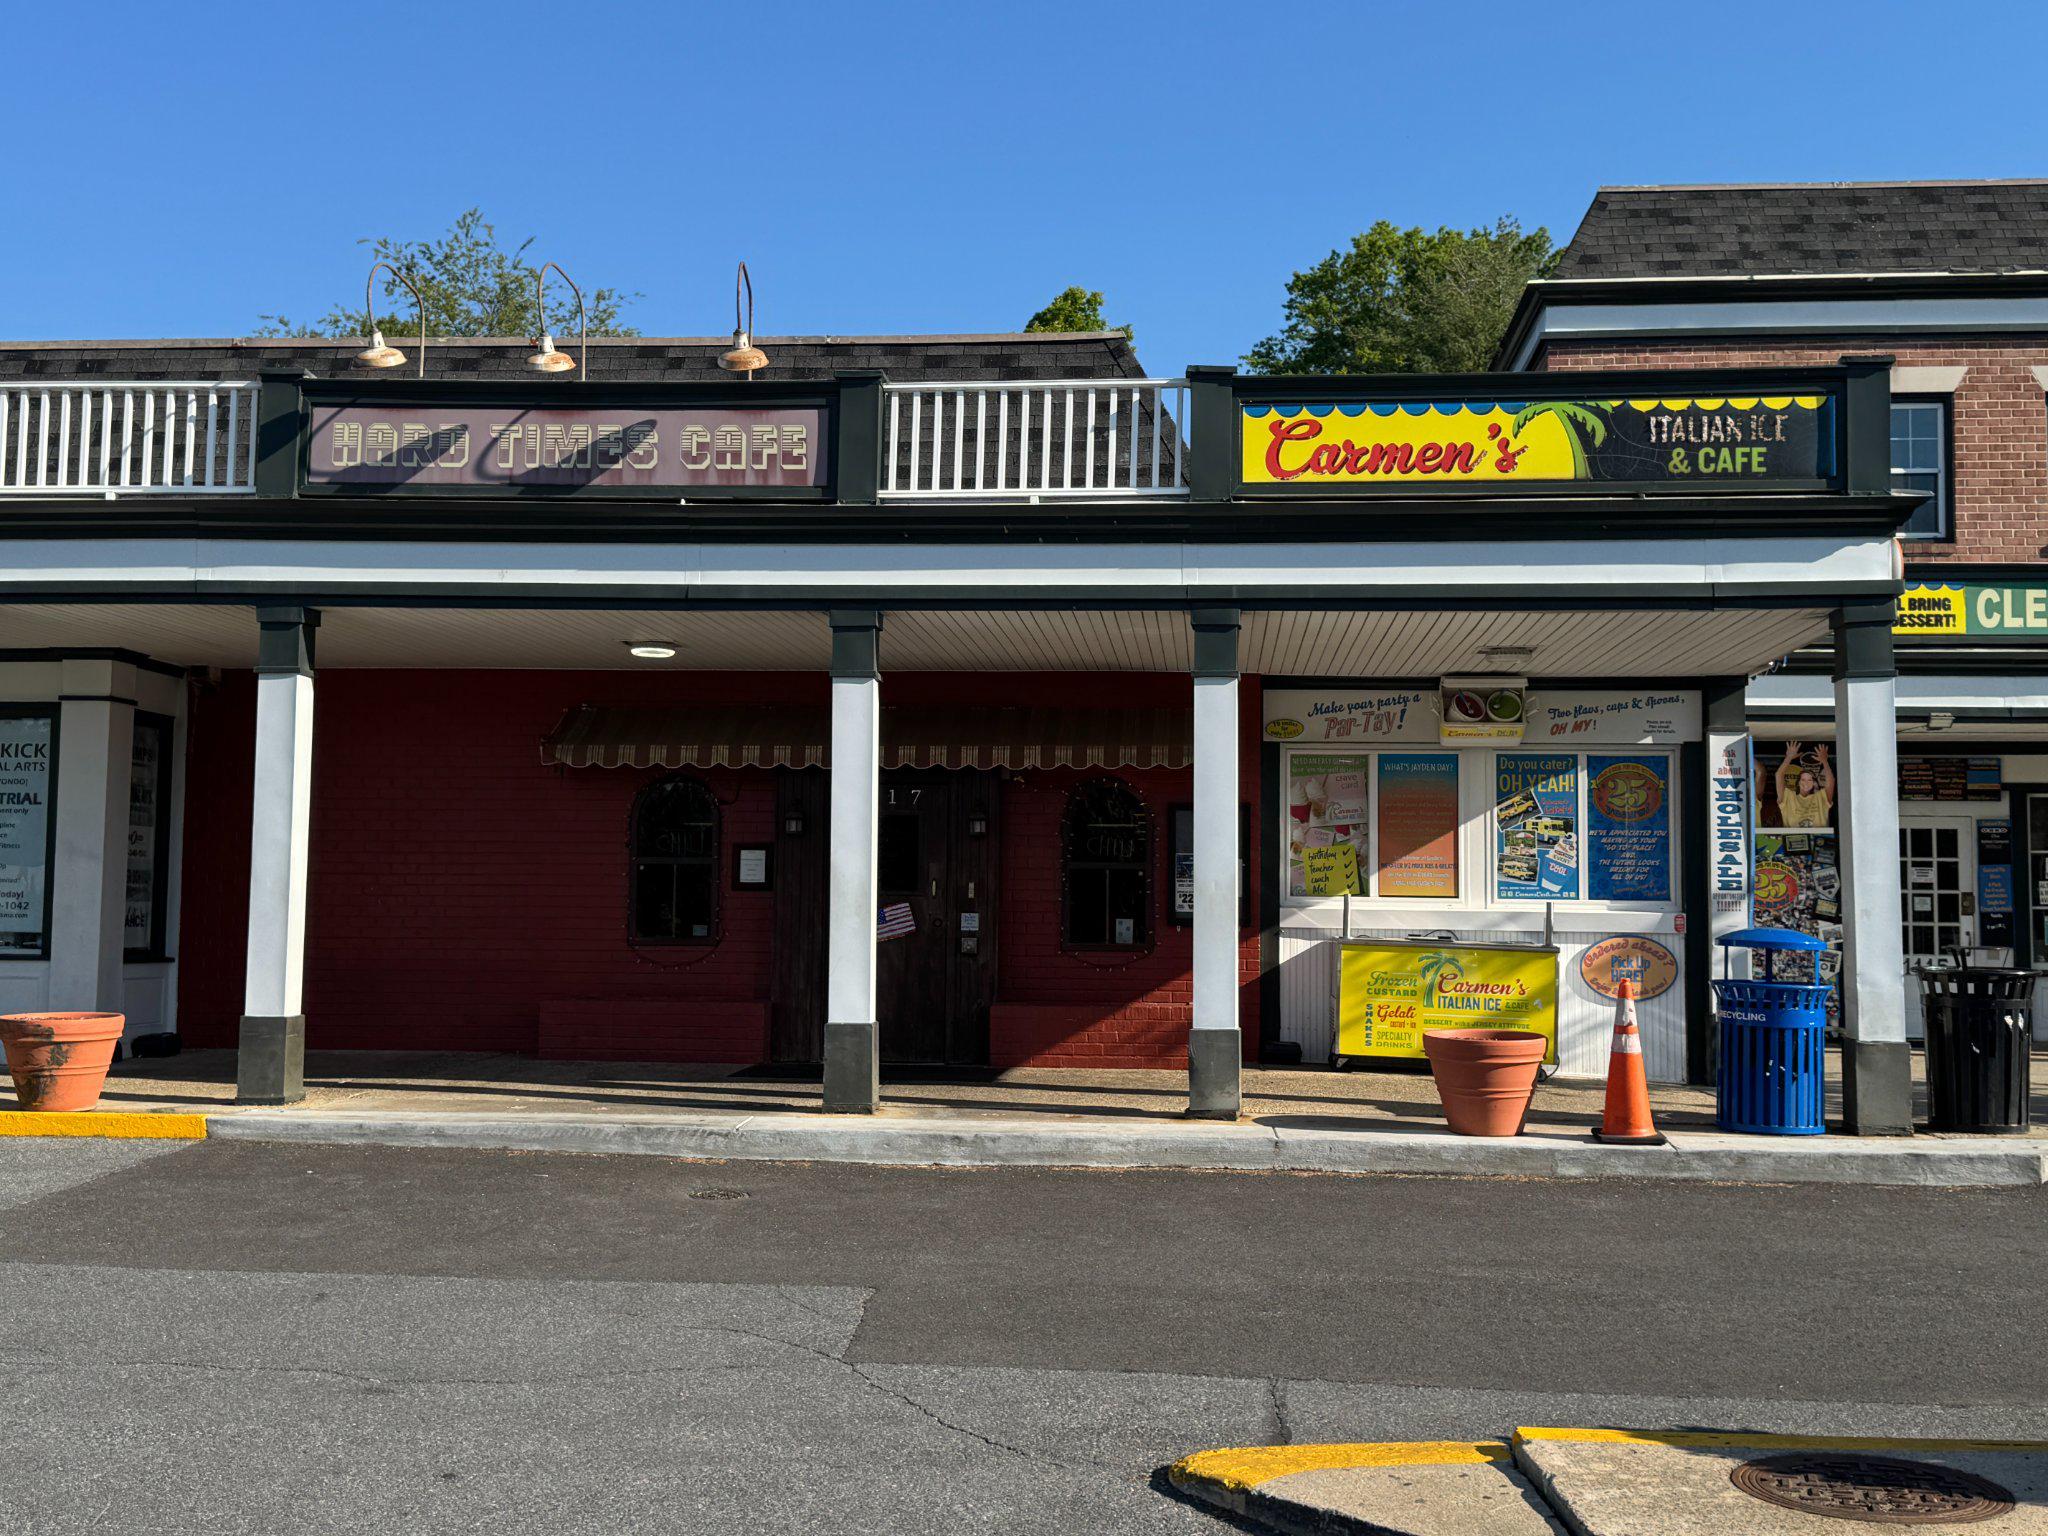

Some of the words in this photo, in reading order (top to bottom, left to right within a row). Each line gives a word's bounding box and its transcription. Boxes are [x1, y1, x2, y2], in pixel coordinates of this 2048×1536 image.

[1650, 415, 1743, 442] ITALIAN
[1750, 415, 1788, 441] ICE
[332, 422, 470, 468] HARD
[489, 423, 659, 470] TIMES
[680, 423, 807, 470] CAFE
[1265, 419, 1529, 480] Carmen's
[1668, 447, 1691, 473] &
[1698, 447, 1768, 473] CAFE
[1908, 597, 1952, 611] BRING
[1977, 588, 2048, 629] CLE
[1308, 701, 1344, 717] Make
[1347, 699, 1375, 714] your
[1377, 694, 1411, 710] party
[1413, 693, 1421, 703] a
[1548, 708, 1572, 720] Two
[1606, 702, 1629, 713] cups
[1631, 698, 1642, 709] &
[1324, 708, 1407, 739] Par-Tay!
[1550, 722, 1568, 736] OH
[1571, 719, 1597, 734] MY!
[14, 762, 45, 771] ARTS
[1501, 757, 1515, 769] Do
[1518, 759, 1538, 772] you
[1540, 757, 1573, 770] cater?
[1500, 774, 1522, 792] OH
[1527, 774, 1575, 792] YEAH!
[0, 793, 42, 805] TRIAL
[1608, 778, 1648, 807] 25
[1713, 777, 1746, 891] WHOLESALE
[1583, 938, 1629, 968] Ordered
[1611, 955, 1634, 969] Pick
[1636, 955, 1651, 969] Up
[1367, 971, 1418, 987] Frozen
[1438, 973, 1530, 996] Carmen's
[1611, 969, 1645, 982] HERE!
[1366, 988, 1418, 997] CUSTARD
[1438, 995, 1480, 1010] ITALIAN
[1483, 997, 1501, 1011] ICE
[1511, 1001, 1530, 1010] CAFE
[1377, 1004, 1417, 1022] Gelati
[1717, 1010, 1766, 1021] RECYCLING
[1376, 1031, 1412, 1041] SPECIALTY
[1376, 1041, 1413, 1049] DRINKS
